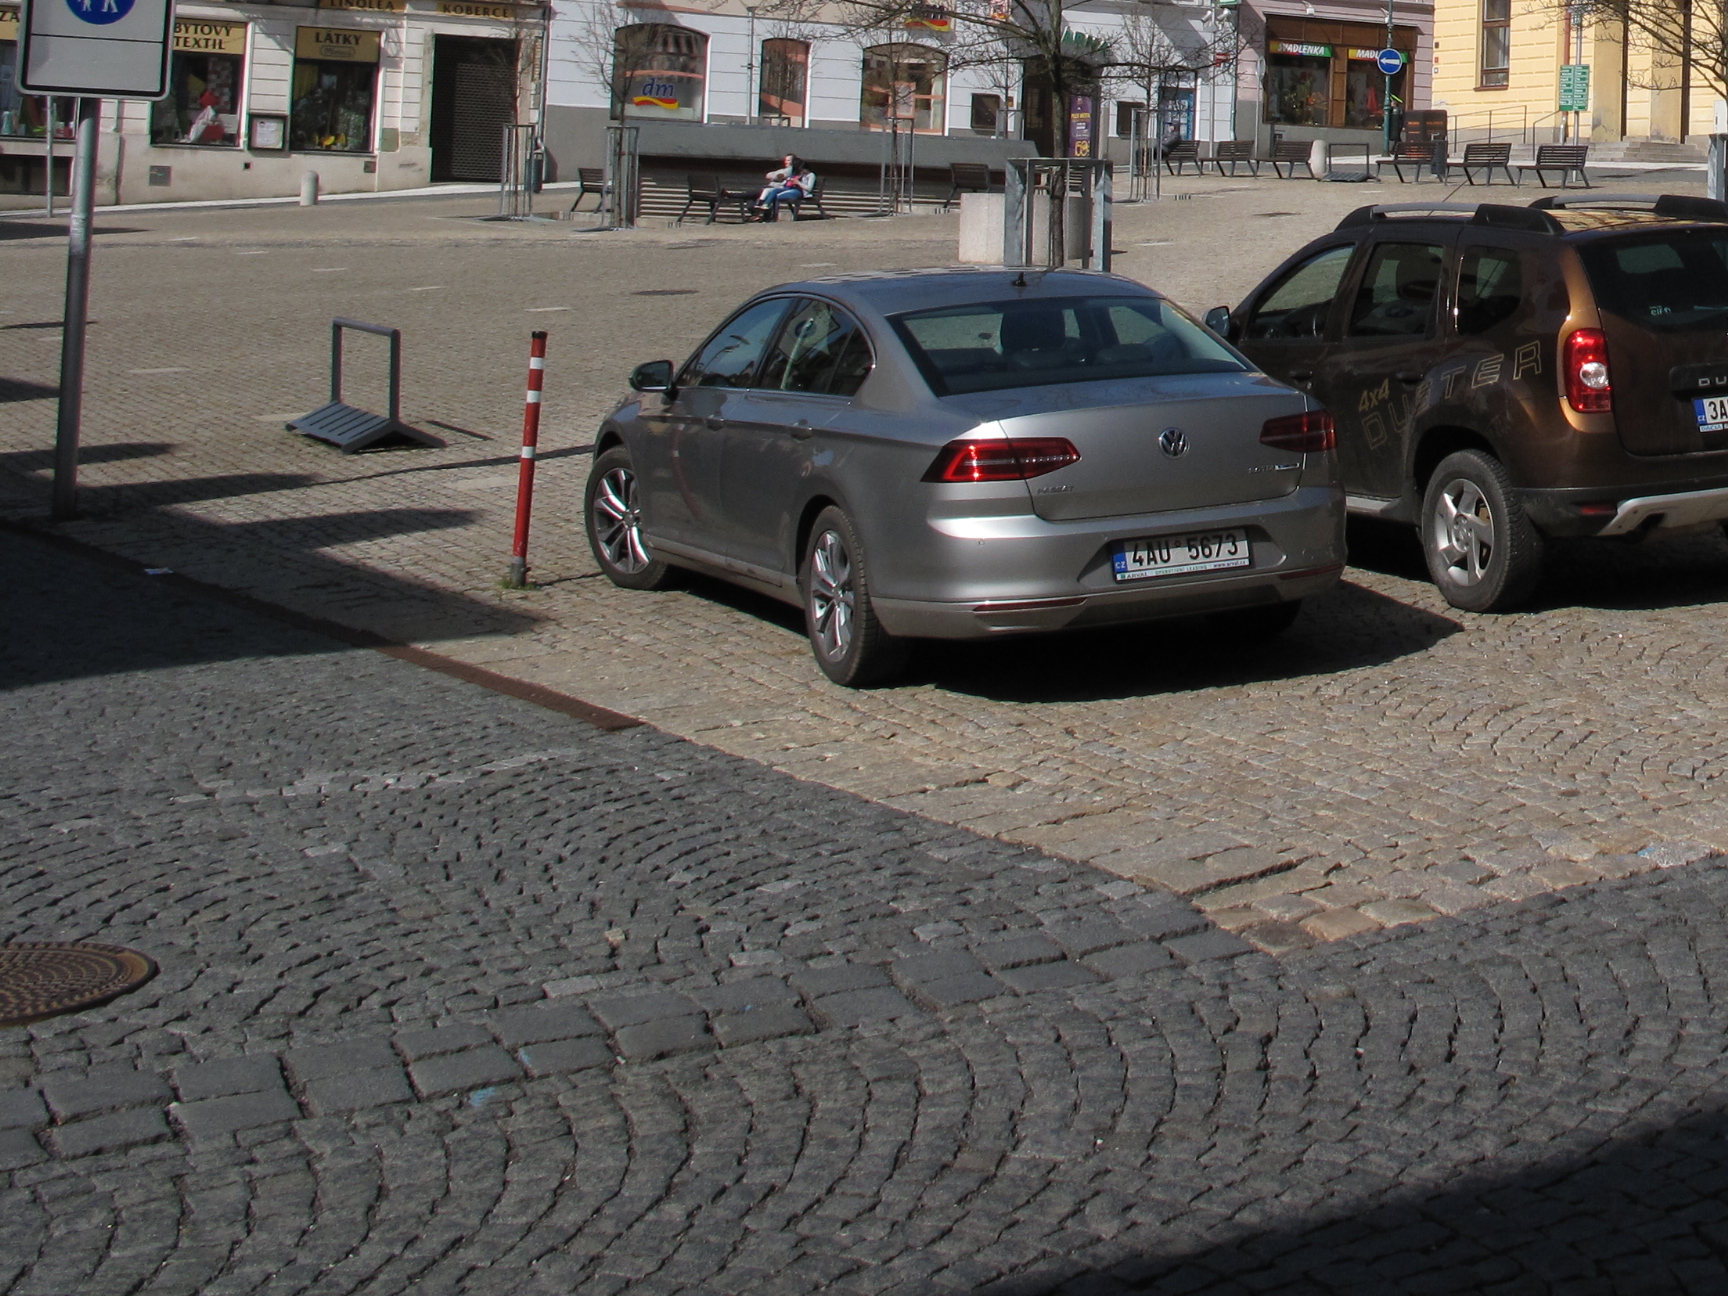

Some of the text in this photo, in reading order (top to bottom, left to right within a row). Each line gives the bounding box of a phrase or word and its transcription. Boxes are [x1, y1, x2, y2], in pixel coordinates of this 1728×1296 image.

[443, 4, 509, 18] KOBERCE
[175, 36, 226, 50] TEXTIL
[315, 30, 362, 46] LÁTKY
[642, 78, 674, 98] dm
[1359, 378, 1391, 412] 4x4
[1361, 340, 1542, 450] DUSTER
[1132, 533, 1239, 567] 4AU 5673
[1115, 561, 1126, 570] CZ
